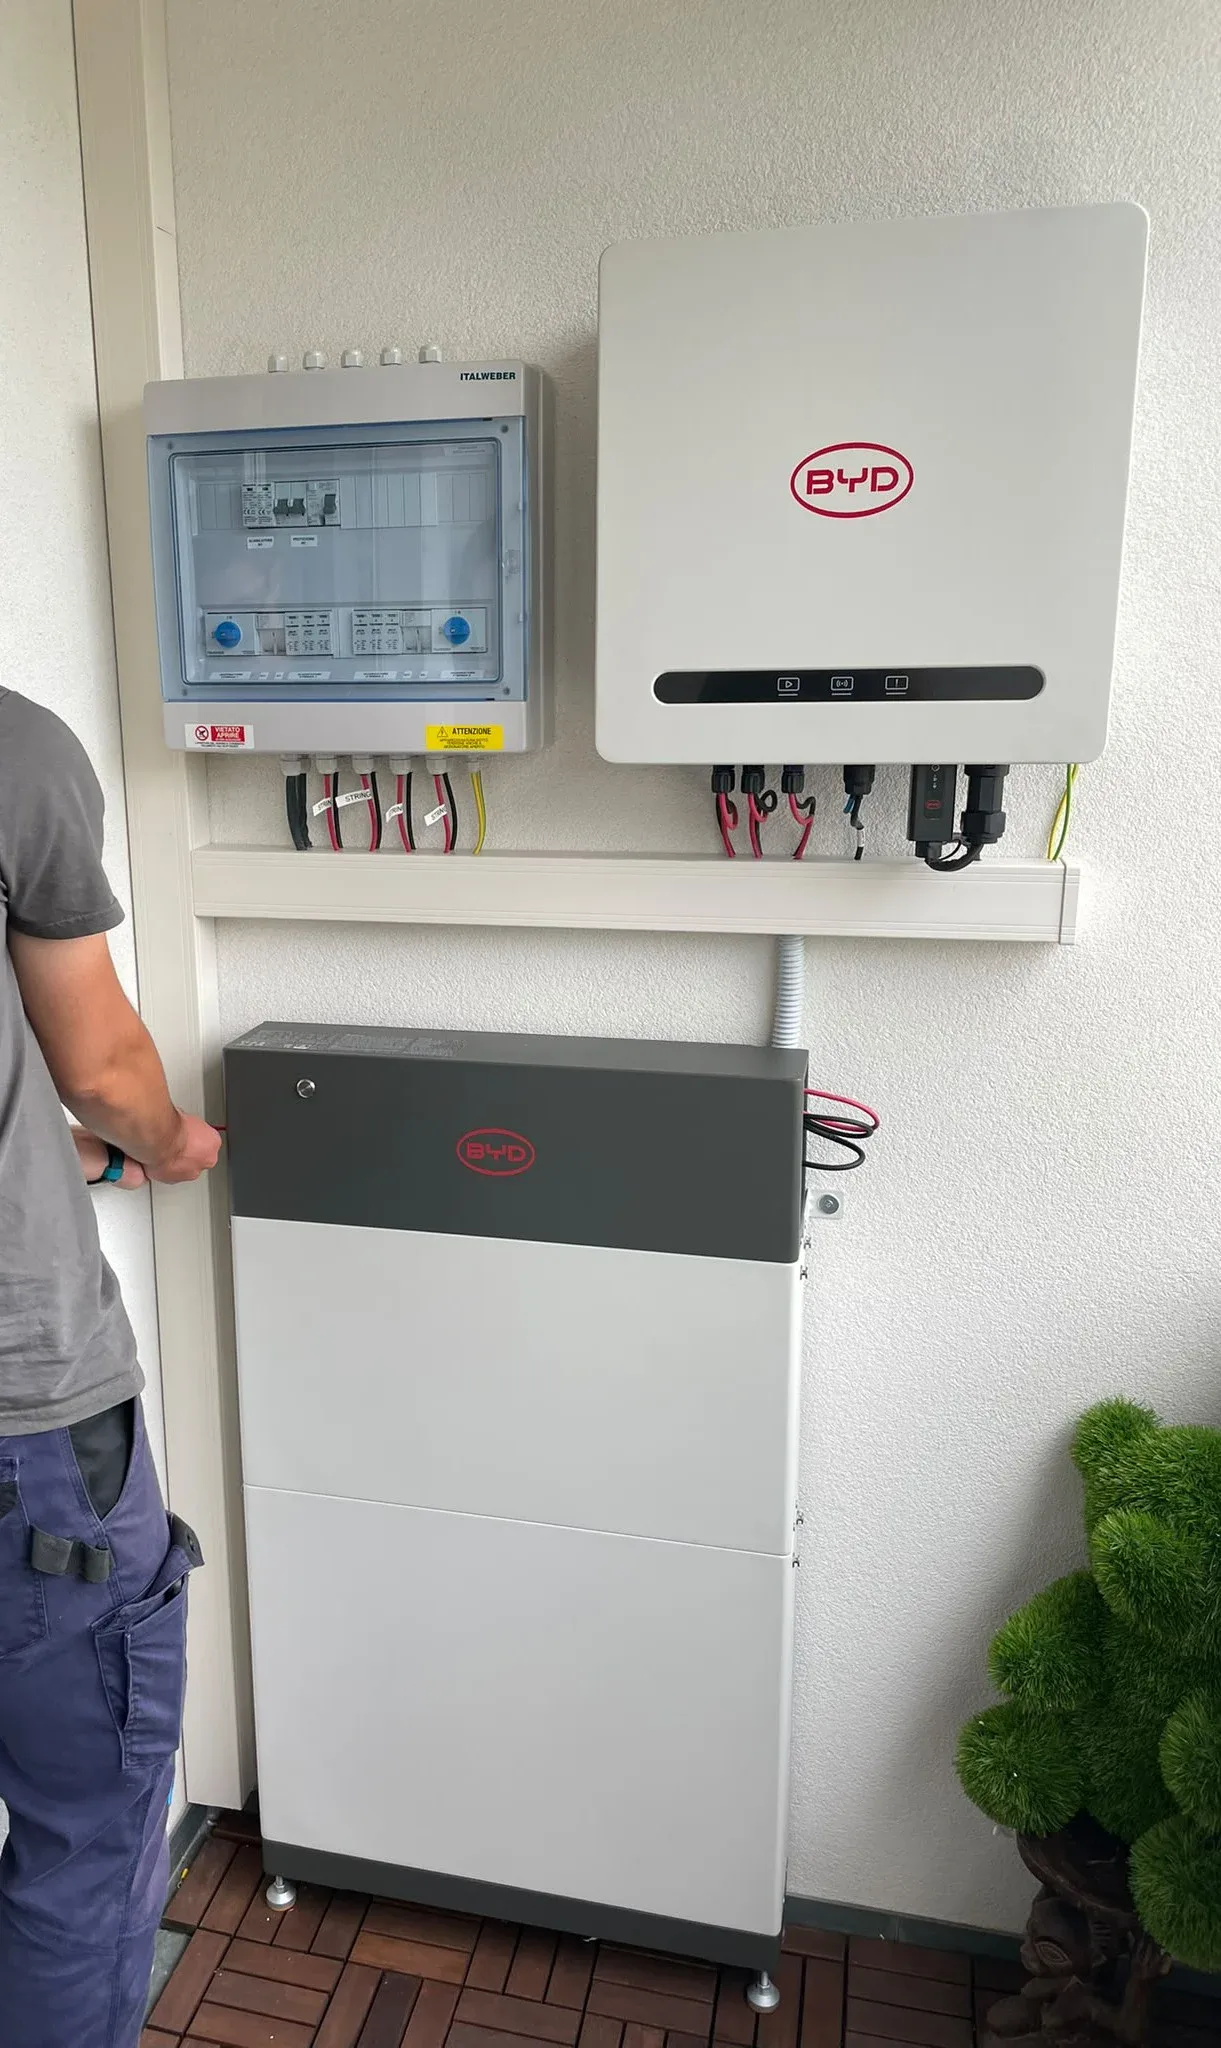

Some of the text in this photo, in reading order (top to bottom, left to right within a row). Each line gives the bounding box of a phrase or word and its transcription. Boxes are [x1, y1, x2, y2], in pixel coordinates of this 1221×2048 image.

[460, 372, 516, 381] ITALWEBER
[806, 466, 899, 495] BYD
[452, 727, 492, 735] ATTENZIONE
[344, 791, 371, 802] STRING
[317, 800, 332, 811] STRIN
[466, 1143, 526, 1163] BYD
